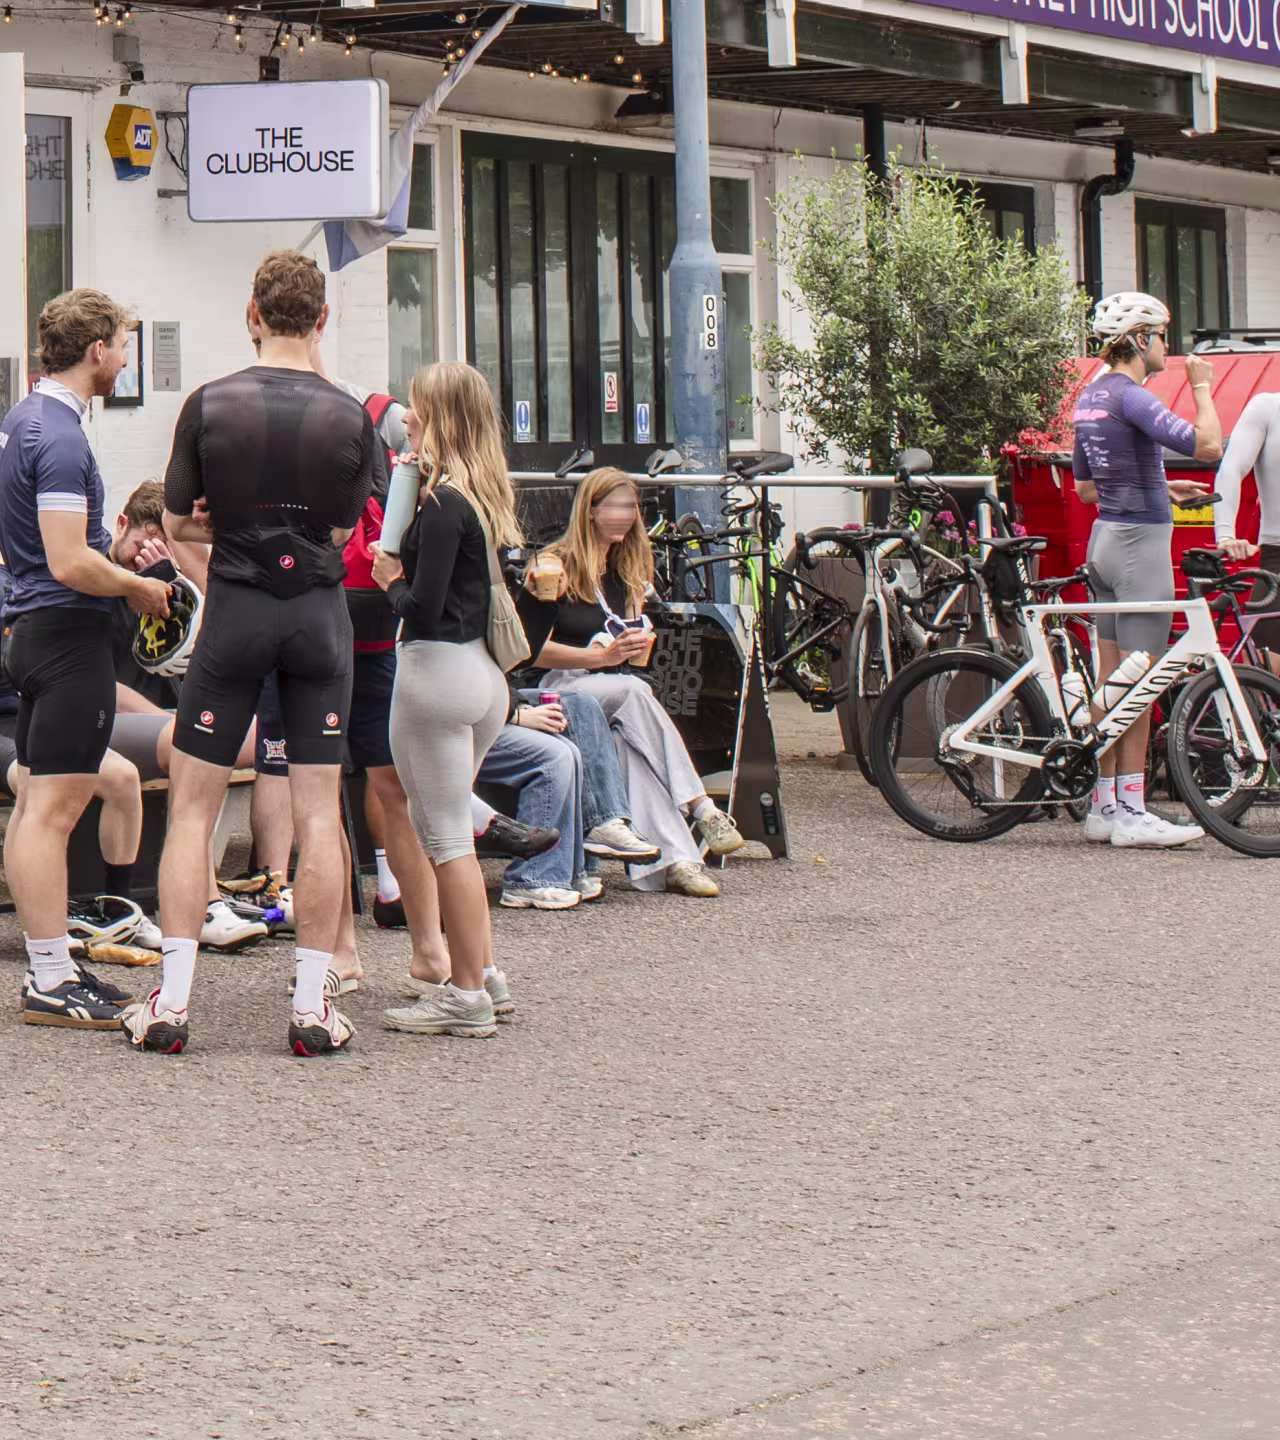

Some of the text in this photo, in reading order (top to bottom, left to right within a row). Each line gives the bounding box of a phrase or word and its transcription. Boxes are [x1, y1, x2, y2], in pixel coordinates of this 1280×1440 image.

[134, 129, 152, 147] ADT
[255, 127, 303, 148] THE
[206, 150, 355, 174] CLUBHOUSE
[654, 629, 703, 651] THE
[653, 650, 702, 673] CLU
[1104, 661, 1187, 739] CANYON
